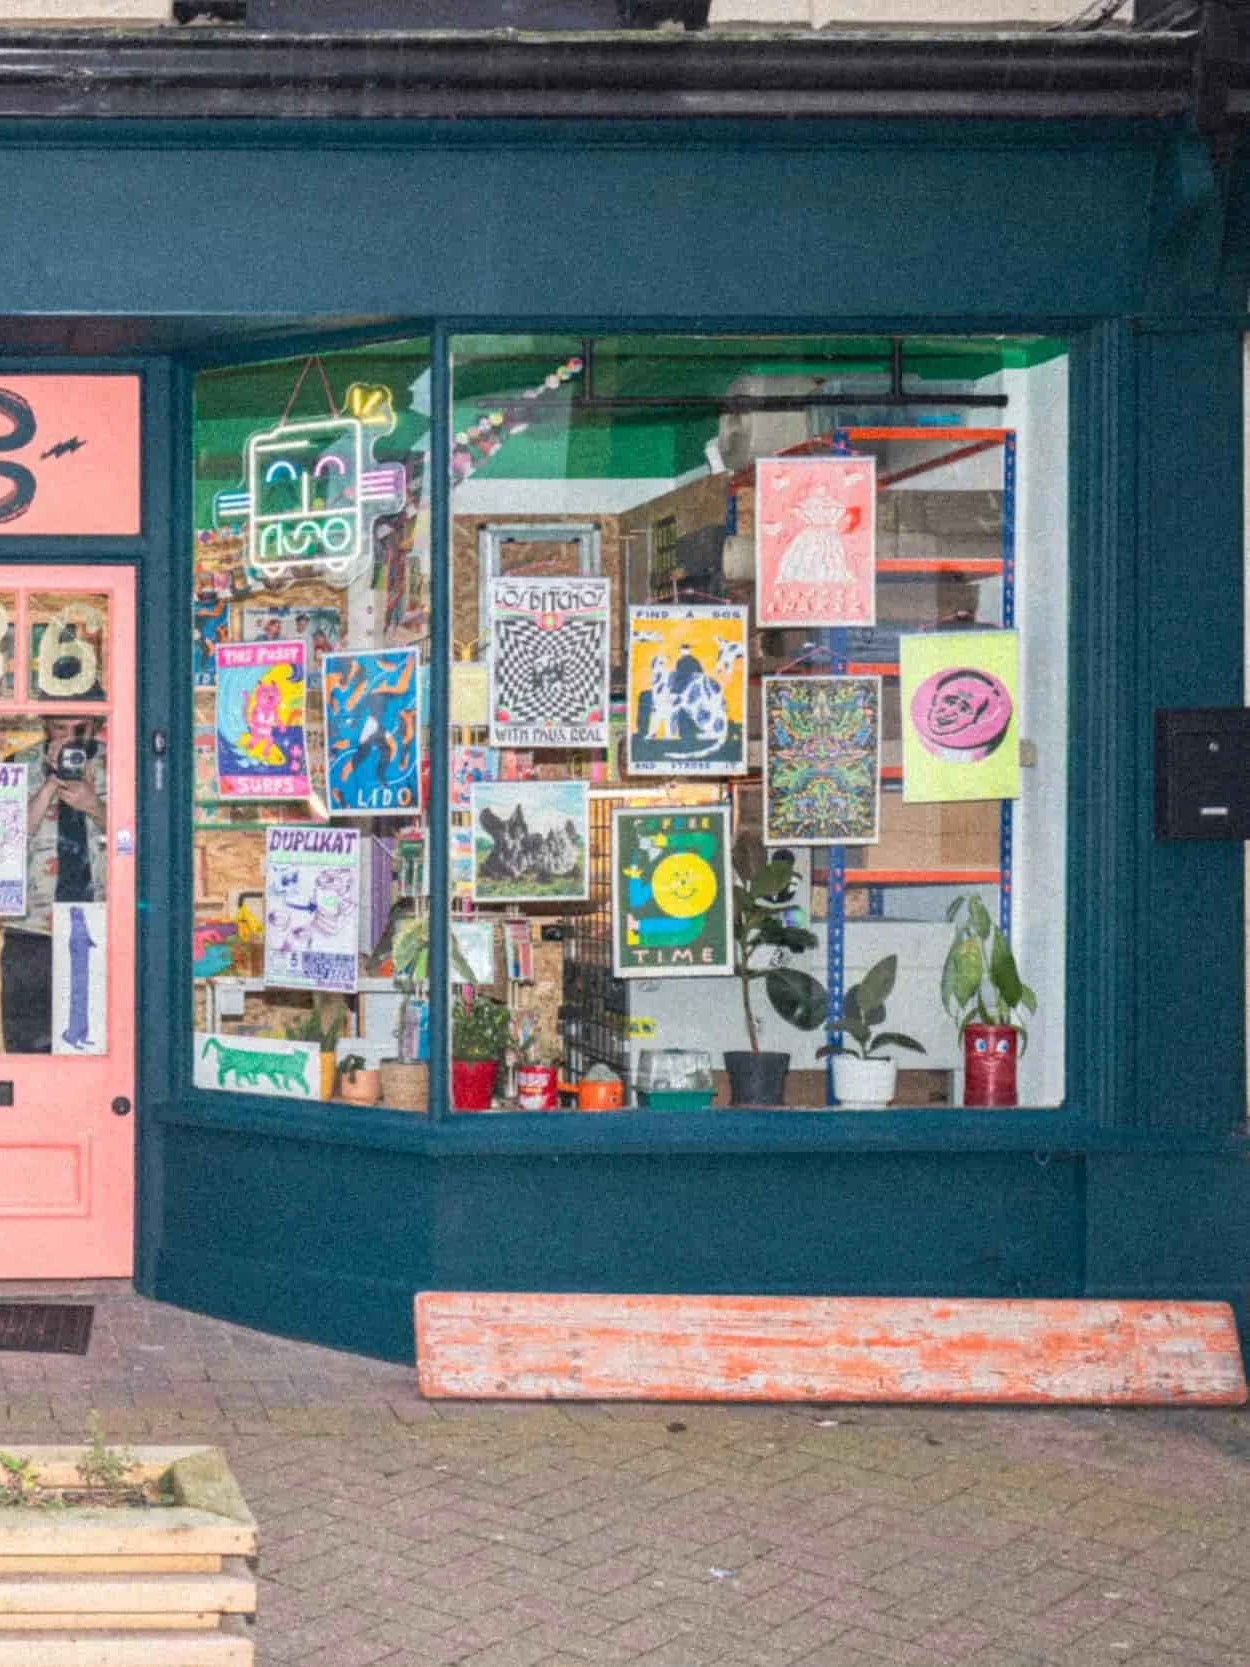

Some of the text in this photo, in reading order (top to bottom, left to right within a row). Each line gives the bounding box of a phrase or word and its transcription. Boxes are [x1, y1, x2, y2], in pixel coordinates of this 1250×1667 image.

[223, 649, 253, 664] THIS
[237, 776, 295, 794] SURFS
[357, 787, 412, 807] LIDO
[269, 829, 358, 855] DUPLIKAT
[631, 947, 715, 964] TIME
